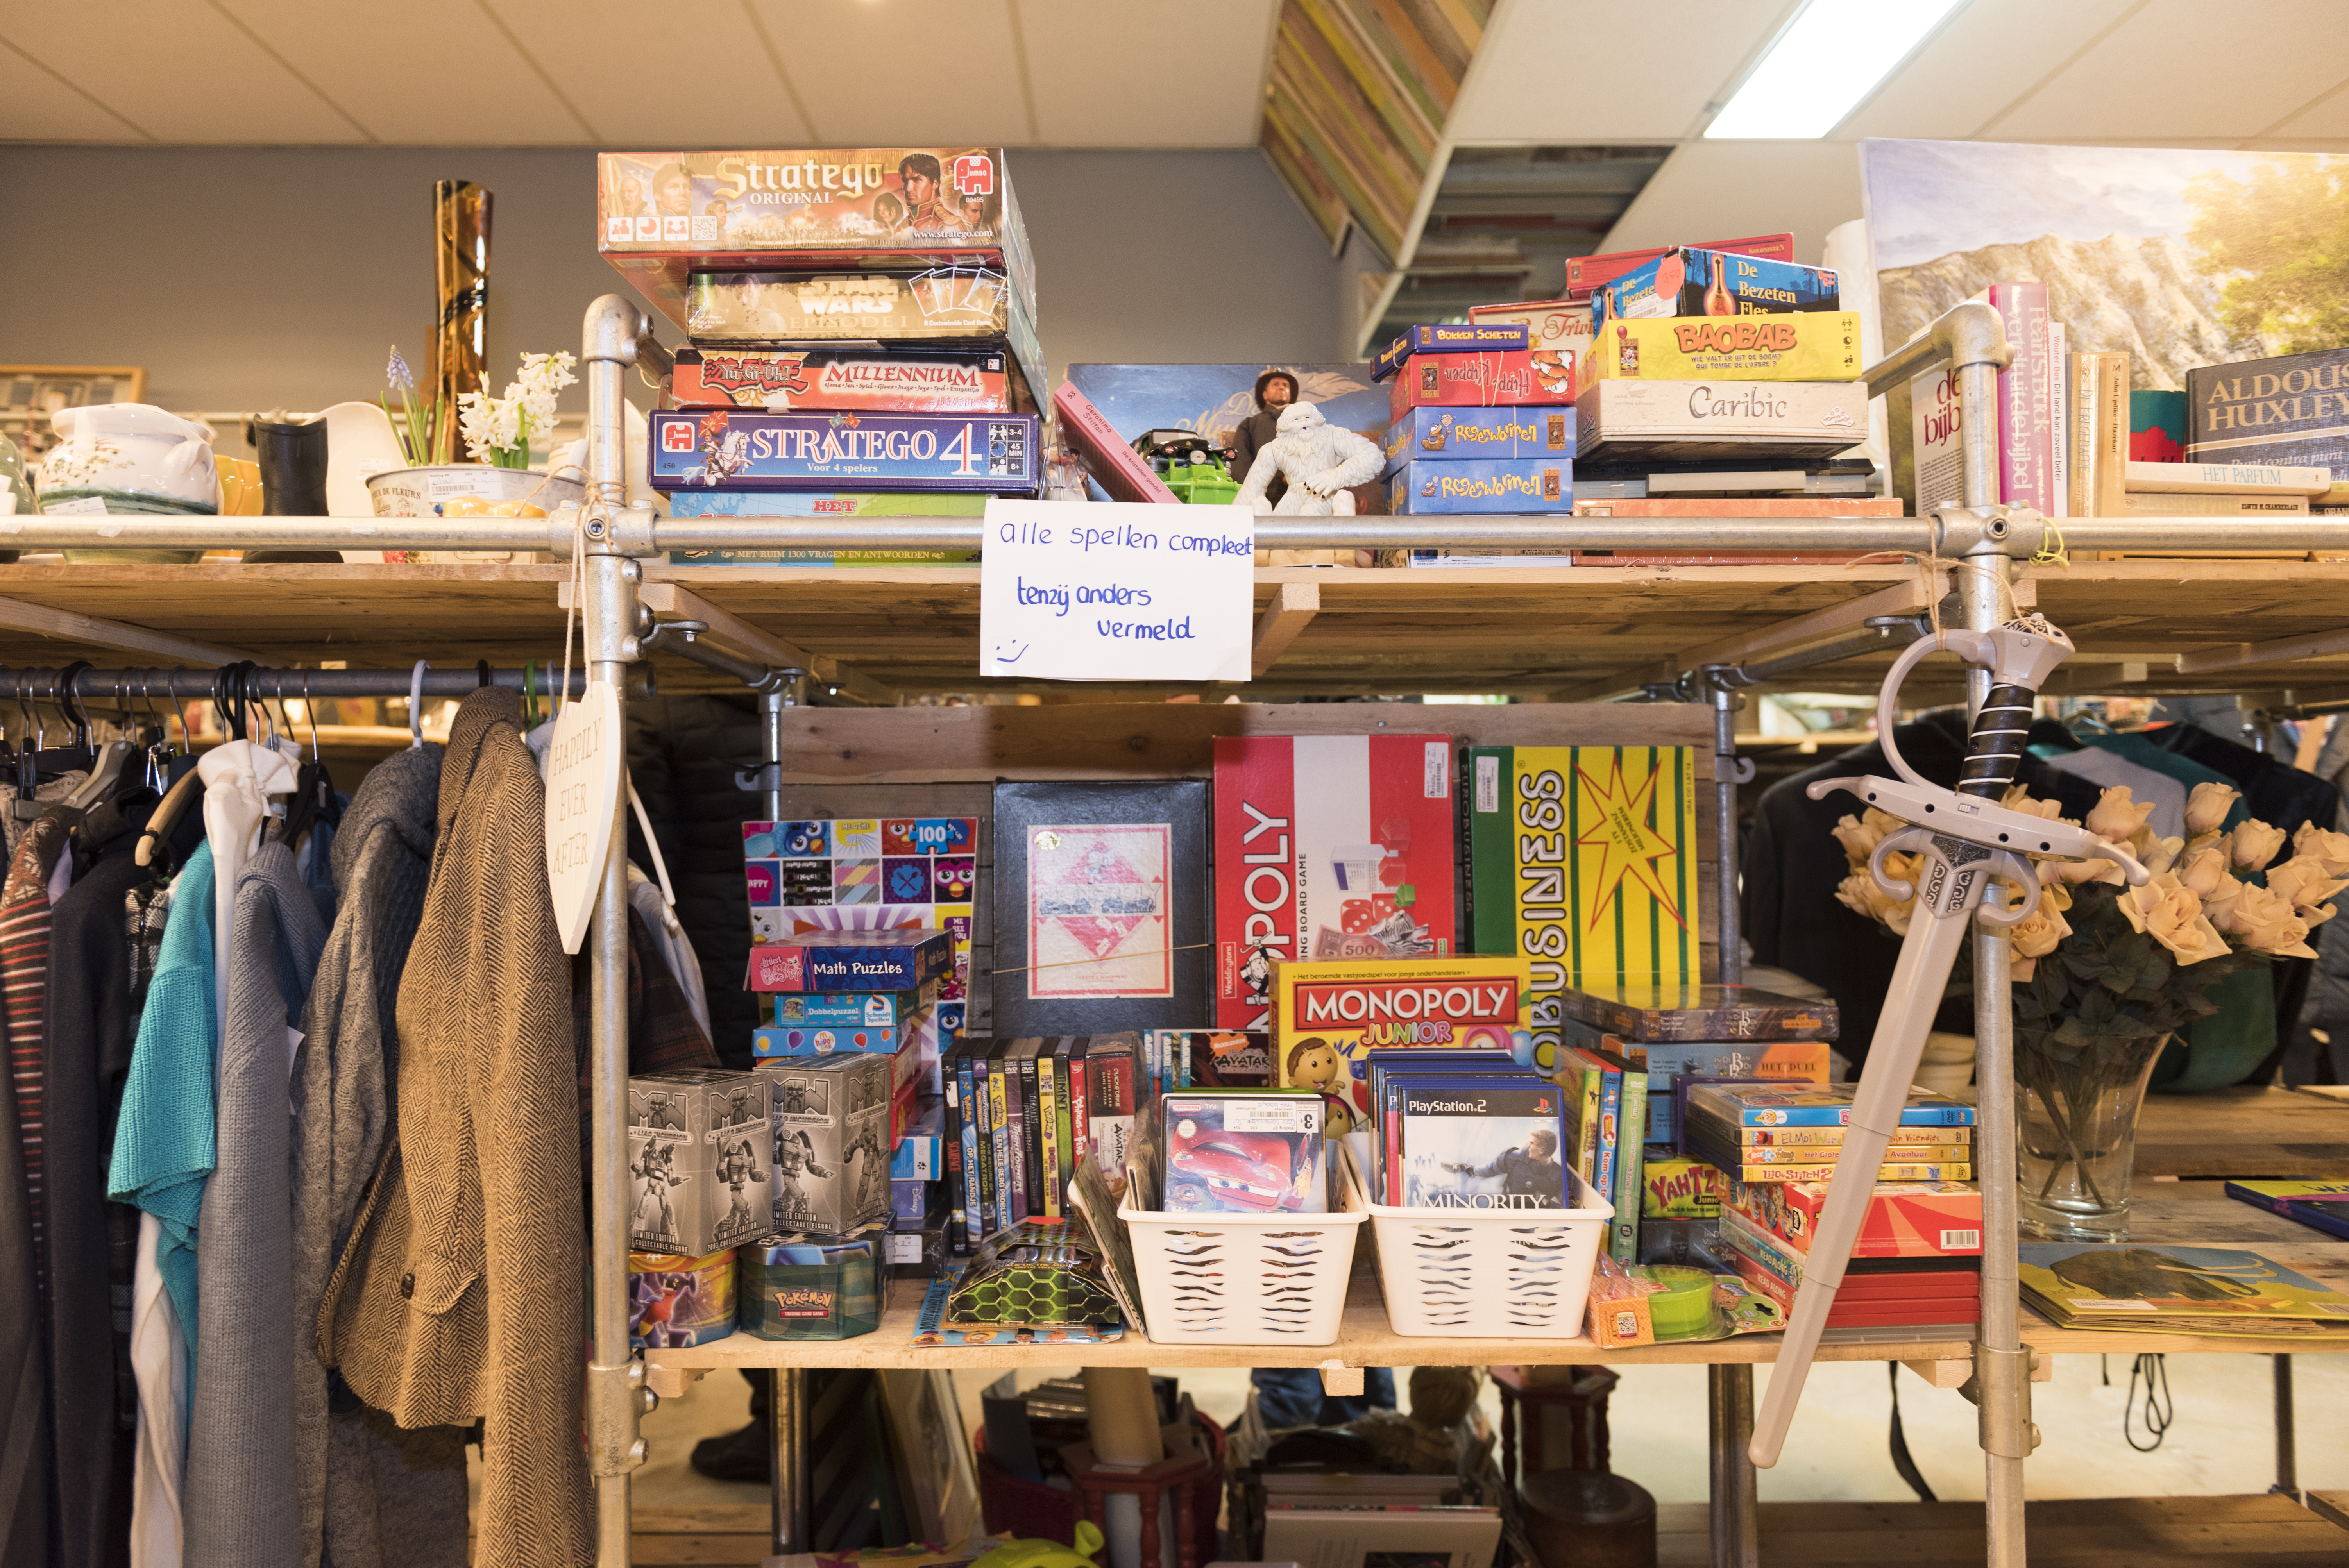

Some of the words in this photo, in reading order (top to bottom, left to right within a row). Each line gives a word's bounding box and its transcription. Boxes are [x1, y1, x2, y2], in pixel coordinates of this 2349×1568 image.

[712, 156, 884, 202] Stratego
[749, 191, 833, 206] ORIGINAL
[913, 229, 993, 240] www.stratego.com
[1737, 261, 1758, 278] De
[1622, 278, 1636, 293] De
[1739, 281, 1797, 304] Bezeten
[798, 295, 899, 314] WARS
[791, 316, 896, 329] EPISODE
[2029, 306, 2045, 356] Pearl
[1674, 323, 1798, 354] BAOBAB
[717, 363, 794, 383] Yu-Gi-Oh!
[825, 365, 979, 386] MILLENNIUM
[1445, 359, 1492, 386] Kippen
[1936, 368, 1960, 405] de
[2010, 371, 2029, 397] uit
[1067, 391, 1076, 399] 53
[1688, 385, 1787, 420] Caribic
[2011, 402, 2030, 429] de
[2032, 378, 2048, 434] Buck
[2111, 394, 2119, 418] Updike
[2207, 392, 2349, 431] HUXLEY
[1083, 412, 1103, 434] Stilton
[1086, 404, 1112, 433] Geronimo
[752, 428, 937, 464] STRATEGO
[939, 422, 983, 476] 4
[2311, 450, 2343, 465] punt
[807, 463, 830, 472] Voor
[833, 463, 839, 472] 4
[841, 464, 878, 475] spelers
[2007, 433, 2032, 490] bijbel
[1128, 456, 1147, 479] kristallen
[1146, 477, 1161, 494] gondel
[2202, 467, 2227, 482] HET
[2232, 467, 2282, 485] PARFUM
[392, 487, 422, 500] FLEURS
[812, 499, 857, 513] HET
[1000, 522, 1053, 544] alle
[1070, 524, 1158, 552] spellen
[1169, 535, 1253, 556] compleet
[737, 550, 760, 559] MET
[762, 550, 787, 559] RUIM
[789, 550, 806, 559] 1300
[808, 550, 844, 559] VRAGEN
[848, 550, 860, 559] EN
[862, 550, 930, 559] ANTWOORDEN
[1017, 576, 1069, 617] tenzij
[1076, 583, 1152, 606] anders
[1097, 616, 1196, 641] vermeld
[553, 717, 603, 777] HAPPILY
[559, 782, 587, 822] EVER
[919, 826, 946, 843] 100
[553, 832, 589, 875] AFTER
[1345, 944, 1374, 955] 500
[759, 955, 782, 970] Littlest
[814, 963, 847, 976] Math
[852, 961, 903, 974] Puzzles
[1342, 972, 1385, 980] vastgoedspel
[807, 1008, 859, 1017] Dobbelpuzzel
[1306, 986, 1509, 1023] MONOPOLY
[1361, 1021, 1453, 1045] JUNIOR
[1789, 1063, 1817, 1071] DUEL
[1056, 1073, 1069, 1114] TMNT
[1072, 1095, 1084, 1129] Phineas
[1408, 1099, 1474, 1115] PlayStation
[789, 1116, 830, 1125] INCURSION
[1075, 1136, 1086, 1155] FERB
[1114, 1123, 1124, 1168] AVATAR
[1905, 1133, 1940, 1142] Vriendjes
[947, 1141, 961, 1172] SCARFACE
[966, 1147, 974, 1158] OP
[1602, 1151, 1611, 1172] Kom
[1889, 1150, 1928, 1158] Avontuur
[980, 1141, 988, 1195] MEGATRON
[1599, 1175, 1608, 1186] op
[1625, 1173, 1633, 1188] Ernie
[909, 1184, 922, 1214] Disney
[968, 1176, 977, 1207] RANDJE
[1422, 1194, 1548, 1209] MINORITY
[794, 1212, 817, 1221] EDITION
[810, 1221, 832, 1230] FIGURE
[635, 1229, 655, 1241] LIMITED
[655, 1232, 676, 1243] EDITION
[707, 1242, 719, 1252] 2003
[719, 1232, 751, 1249] COLLECTABLE
[752, 1226, 769, 1239] FIGURE
[718, 1228, 740, 1241] LIMITED
[741, 1221, 757, 1234] EDITION
[635, 1239, 669, 1250] COLLECTABLE
[669, 1244, 688, 1253] FIGURE
[1760, 1249, 1773, 1265] READ
[1771, 1258, 1789, 1275] ALONG
[1758, 1273, 1772, 1289] READ
[1770, 1281, 1786, 1298] ALONG
